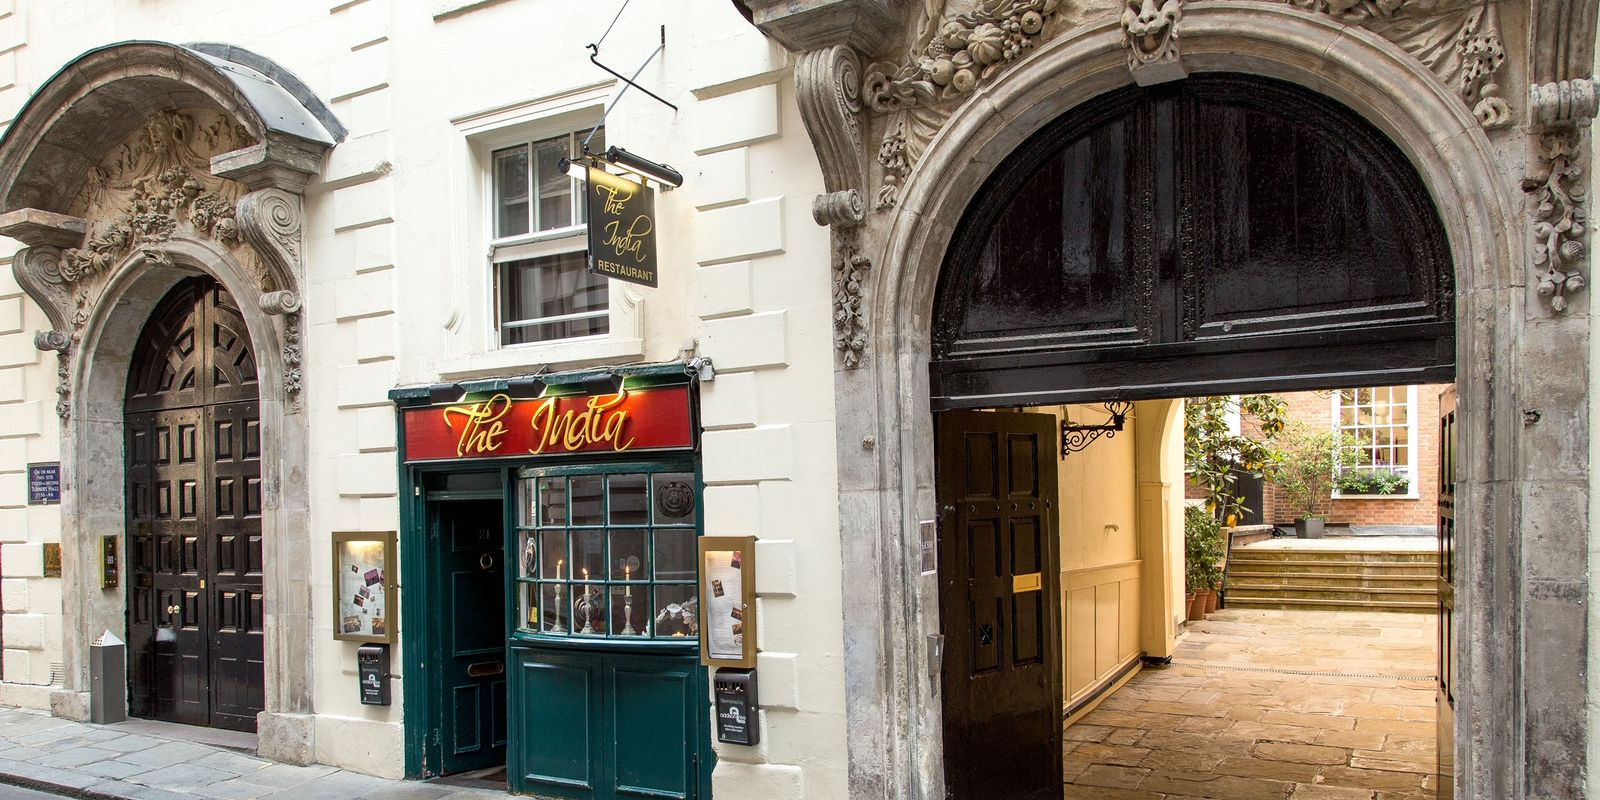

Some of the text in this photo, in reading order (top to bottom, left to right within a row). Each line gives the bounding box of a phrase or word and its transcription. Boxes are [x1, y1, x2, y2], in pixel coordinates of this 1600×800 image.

[596, 183, 632, 215] The
[603, 215, 652, 262] India
[598, 259, 654, 281] RESTAURANT
[443, 388, 635, 457] The India
